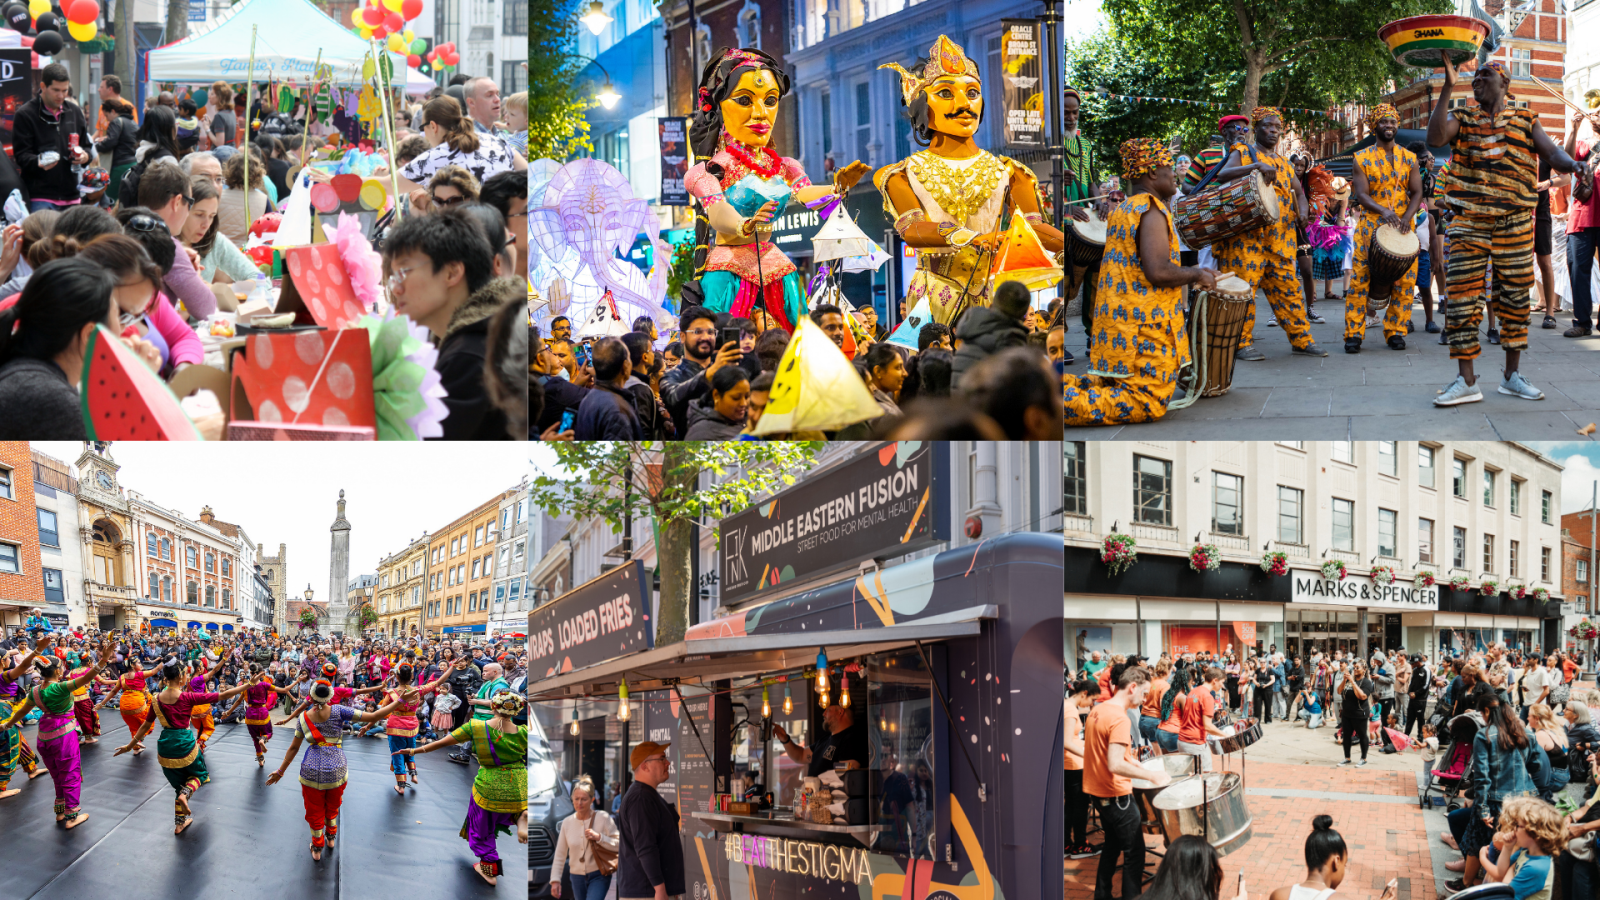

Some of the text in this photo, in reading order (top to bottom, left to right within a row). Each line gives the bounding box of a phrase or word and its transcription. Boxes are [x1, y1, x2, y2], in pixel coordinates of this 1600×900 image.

[1010, 25, 1033, 33] ORACLE
[1414, 28, 1445, 39] GHANA
[1009, 109, 1040, 118] OPEN LATE
[1010, 124, 1041, 132] EVERYDAY
[787, 210, 819, 230] LEWIS
[751, 463, 918, 557] MIDDLE EASTERN FUSION
[797, 495, 919, 554] STREET FOOD FOR MENTAL HEALTH
[1296, 577, 1437, 605] MARKS & SPENCER
[558, 609, 598, 651] LOADED
[599, 593, 633, 636] FRIES
[725, 833, 874, 886] #BEATTHESTIGMA
